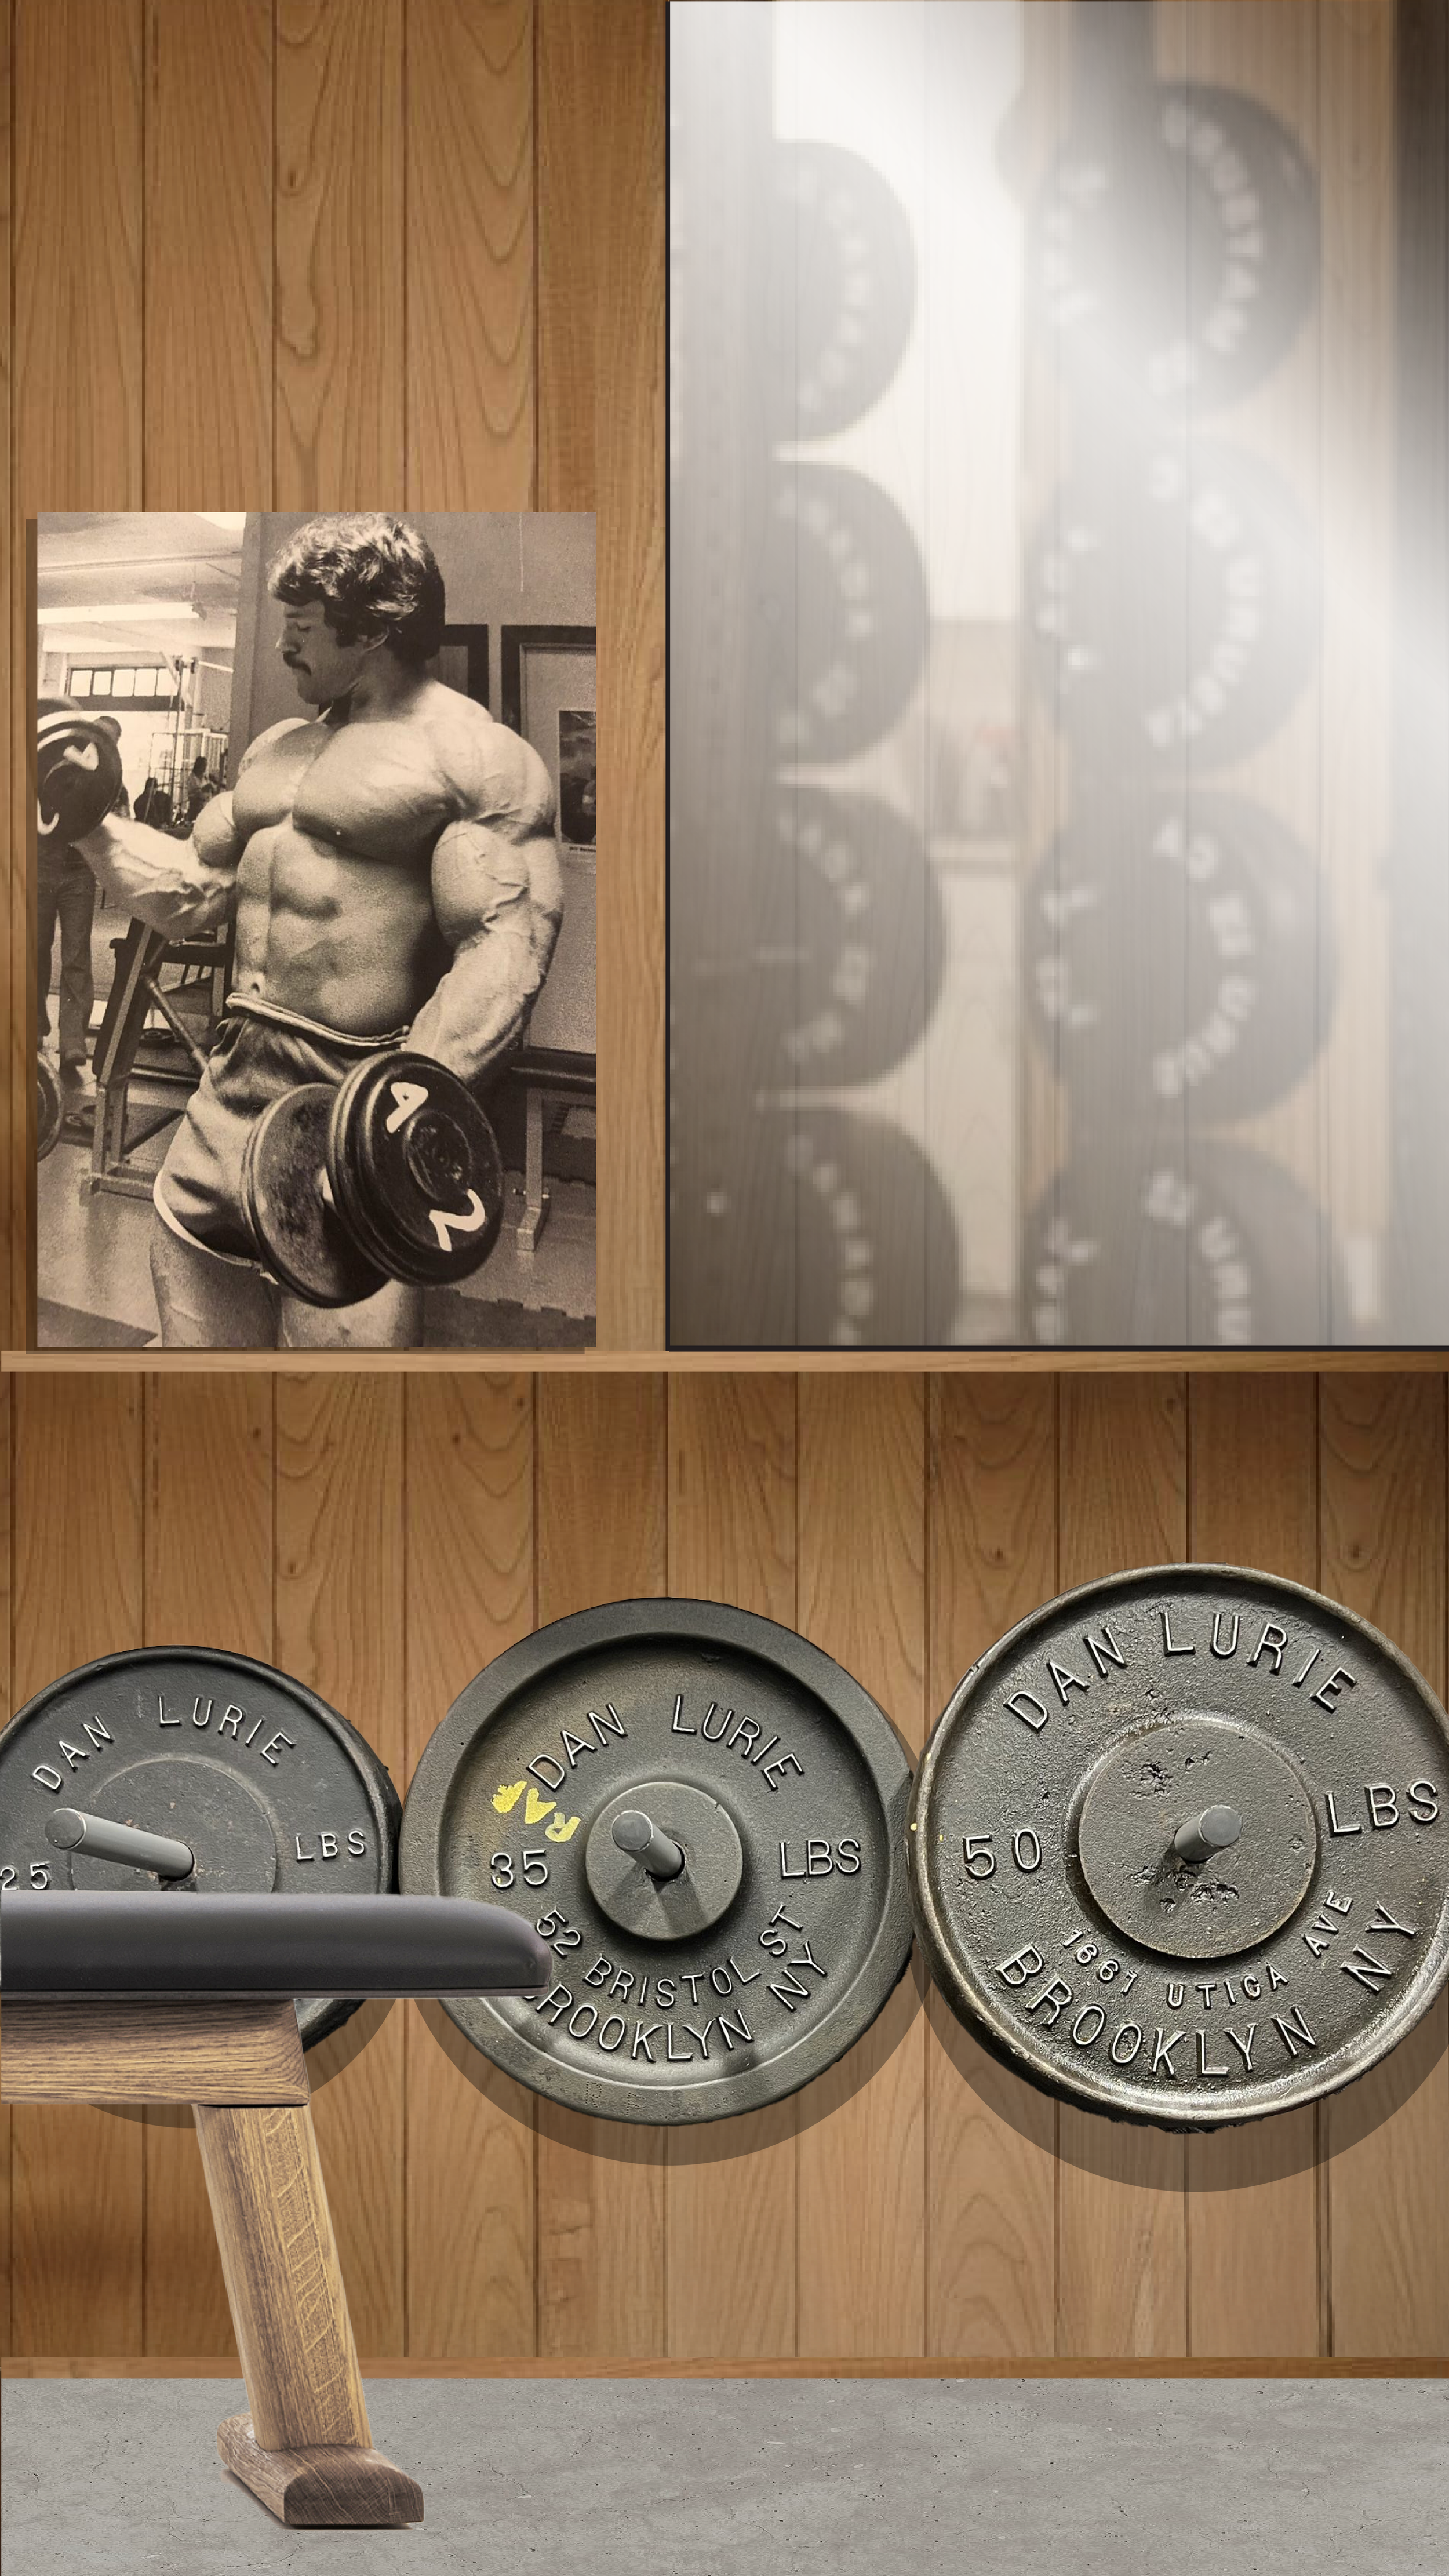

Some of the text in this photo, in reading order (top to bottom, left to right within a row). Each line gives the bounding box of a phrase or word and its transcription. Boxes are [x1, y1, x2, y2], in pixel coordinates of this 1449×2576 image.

[1006, 1613, 1357, 1731] DAN LURIE
[32, 1697, 296, 1791] DAN LURIE
[527, 1696, 803, 1790] DAN LURIE
[0, 1831, 365, 1890] 25 LBS
[490, 1840, 861, 1888] 35 LBS
[962, 1781, 1439, 1879] 50 LBS
[536, 1905, 804, 2007] 52 BRISTOL ST
[996, 1901, 1417, 2076] BROOKLYN NY
[1062, 1890, 1352, 2009] 1661 UTICA AVE
[523, 1942, 827, 2061] ROOKLYN NY
